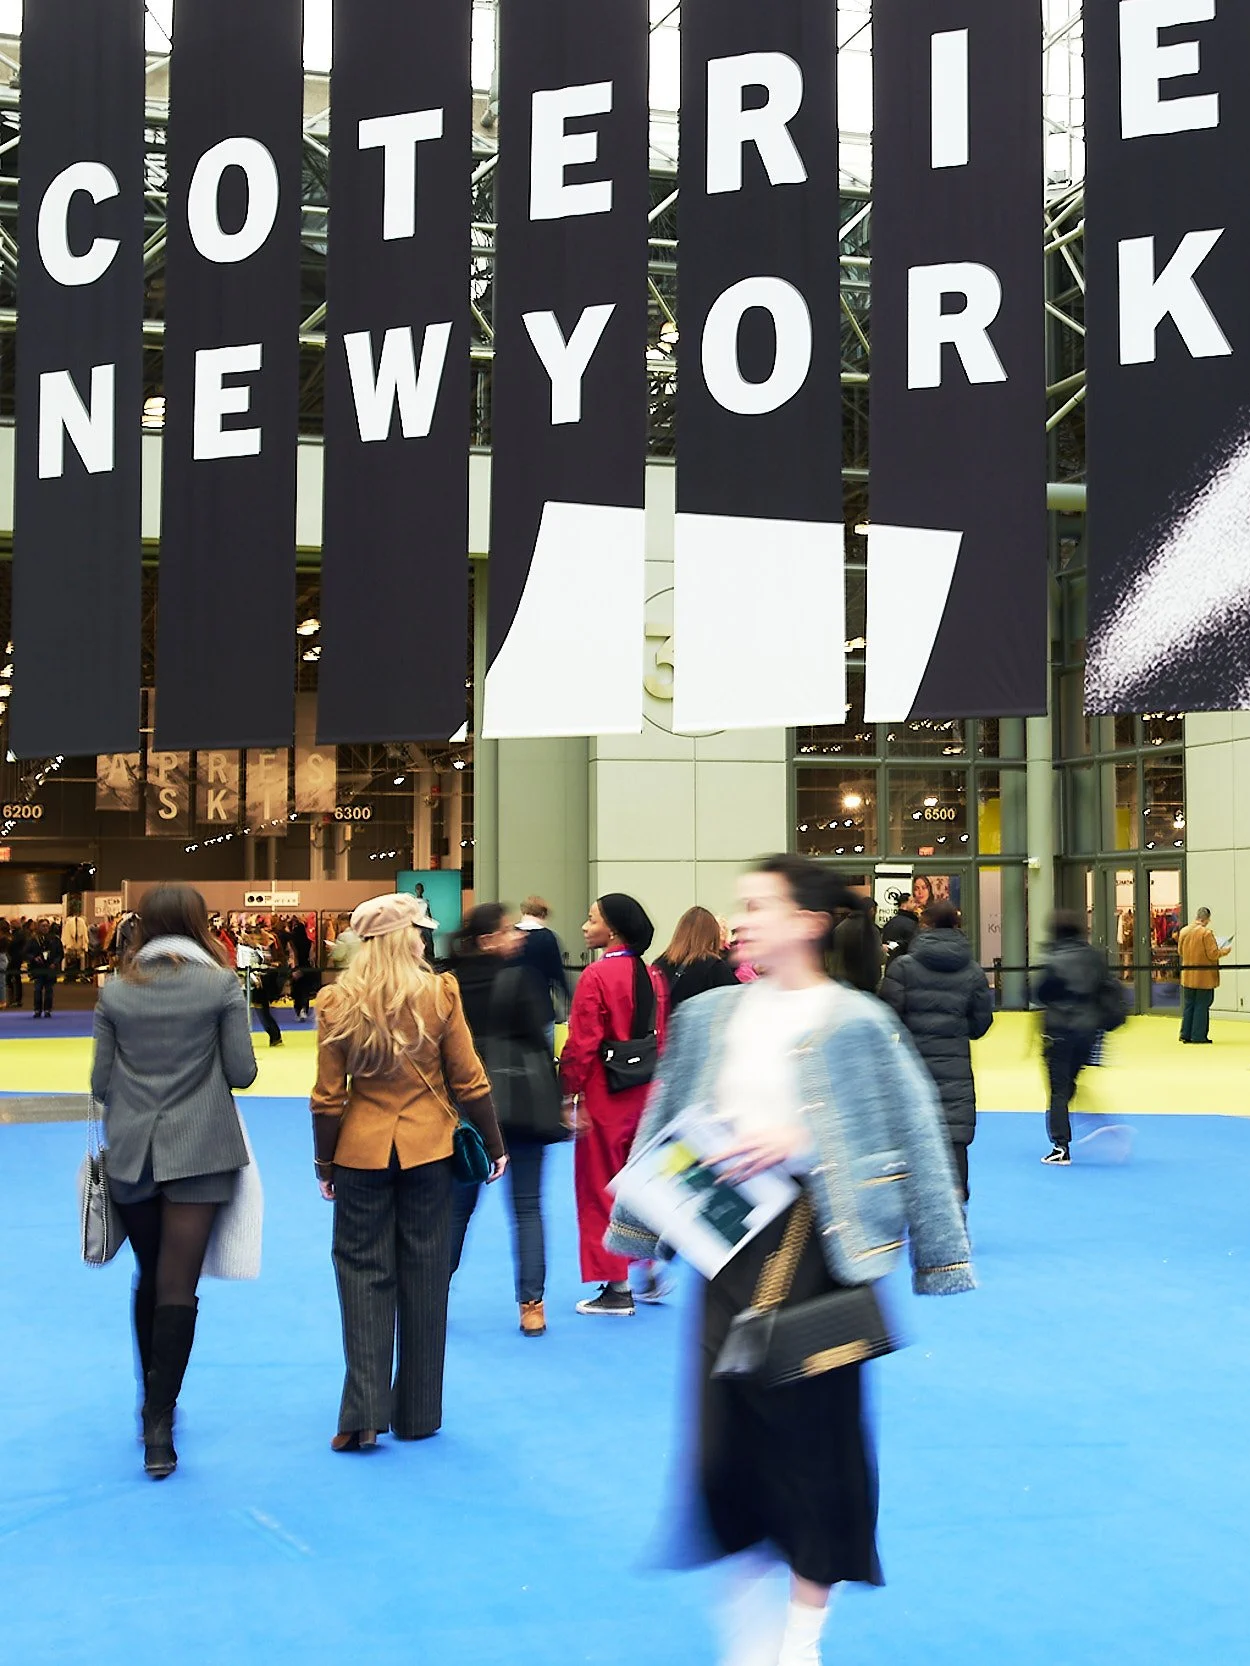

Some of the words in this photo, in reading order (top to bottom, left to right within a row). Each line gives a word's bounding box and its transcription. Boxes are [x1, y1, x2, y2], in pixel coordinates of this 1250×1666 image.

[38, 0, 1220, 286] COTERIE
[38, 322, 453, 479] NEW
[521, 228, 1234, 425] YORK
[3, 805, 42, 818] 6200
[158, 788, 271, 820] SKI
[334, 807, 371, 820] 6300
[924, 808, 956, 820] 6500
